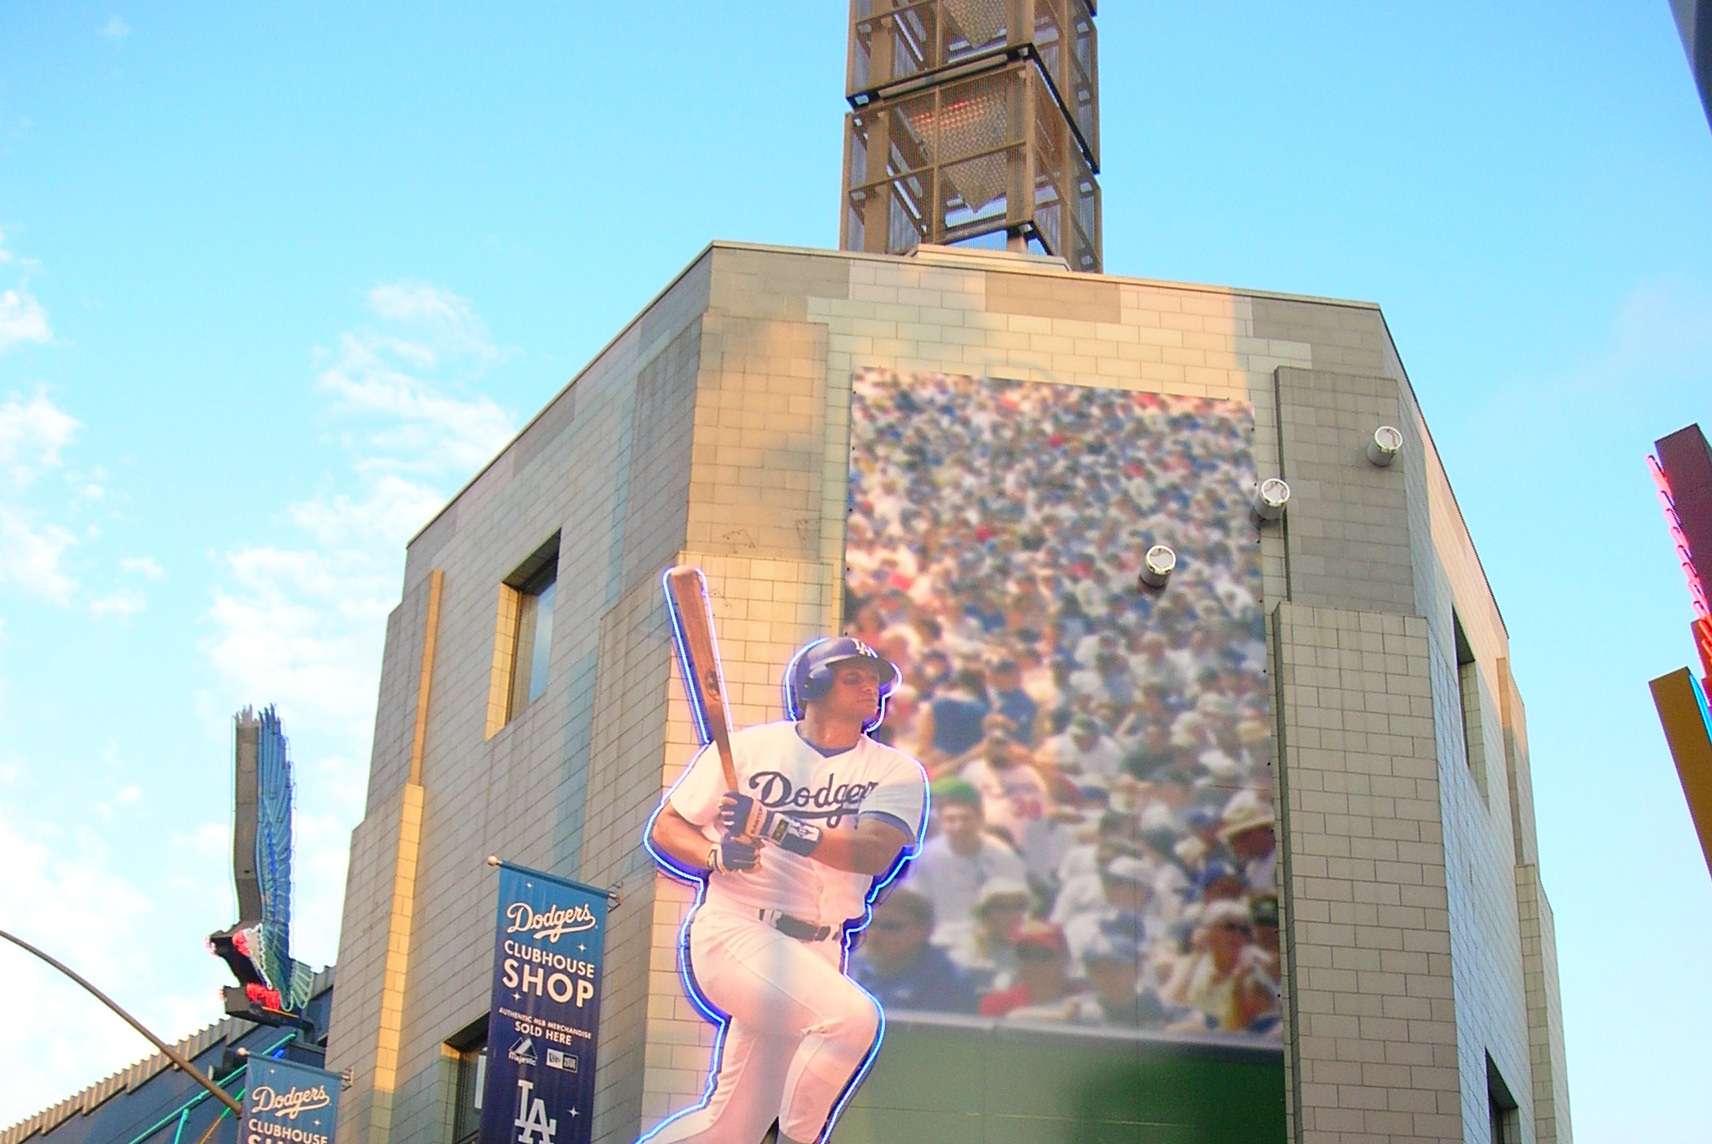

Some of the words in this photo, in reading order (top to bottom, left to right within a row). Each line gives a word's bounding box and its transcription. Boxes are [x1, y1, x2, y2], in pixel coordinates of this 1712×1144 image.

[749, 771, 878, 829] Dodger
[506, 903, 597, 943] Dodgers
[504, 940, 595, 978] CLUBHOUSE
[502, 958, 594, 1008] SHOP
[515, 1021, 542, 1037] SOLD
[545, 1029, 572, 1046] HERE
[251, 1085, 330, 1119] Dodgers
